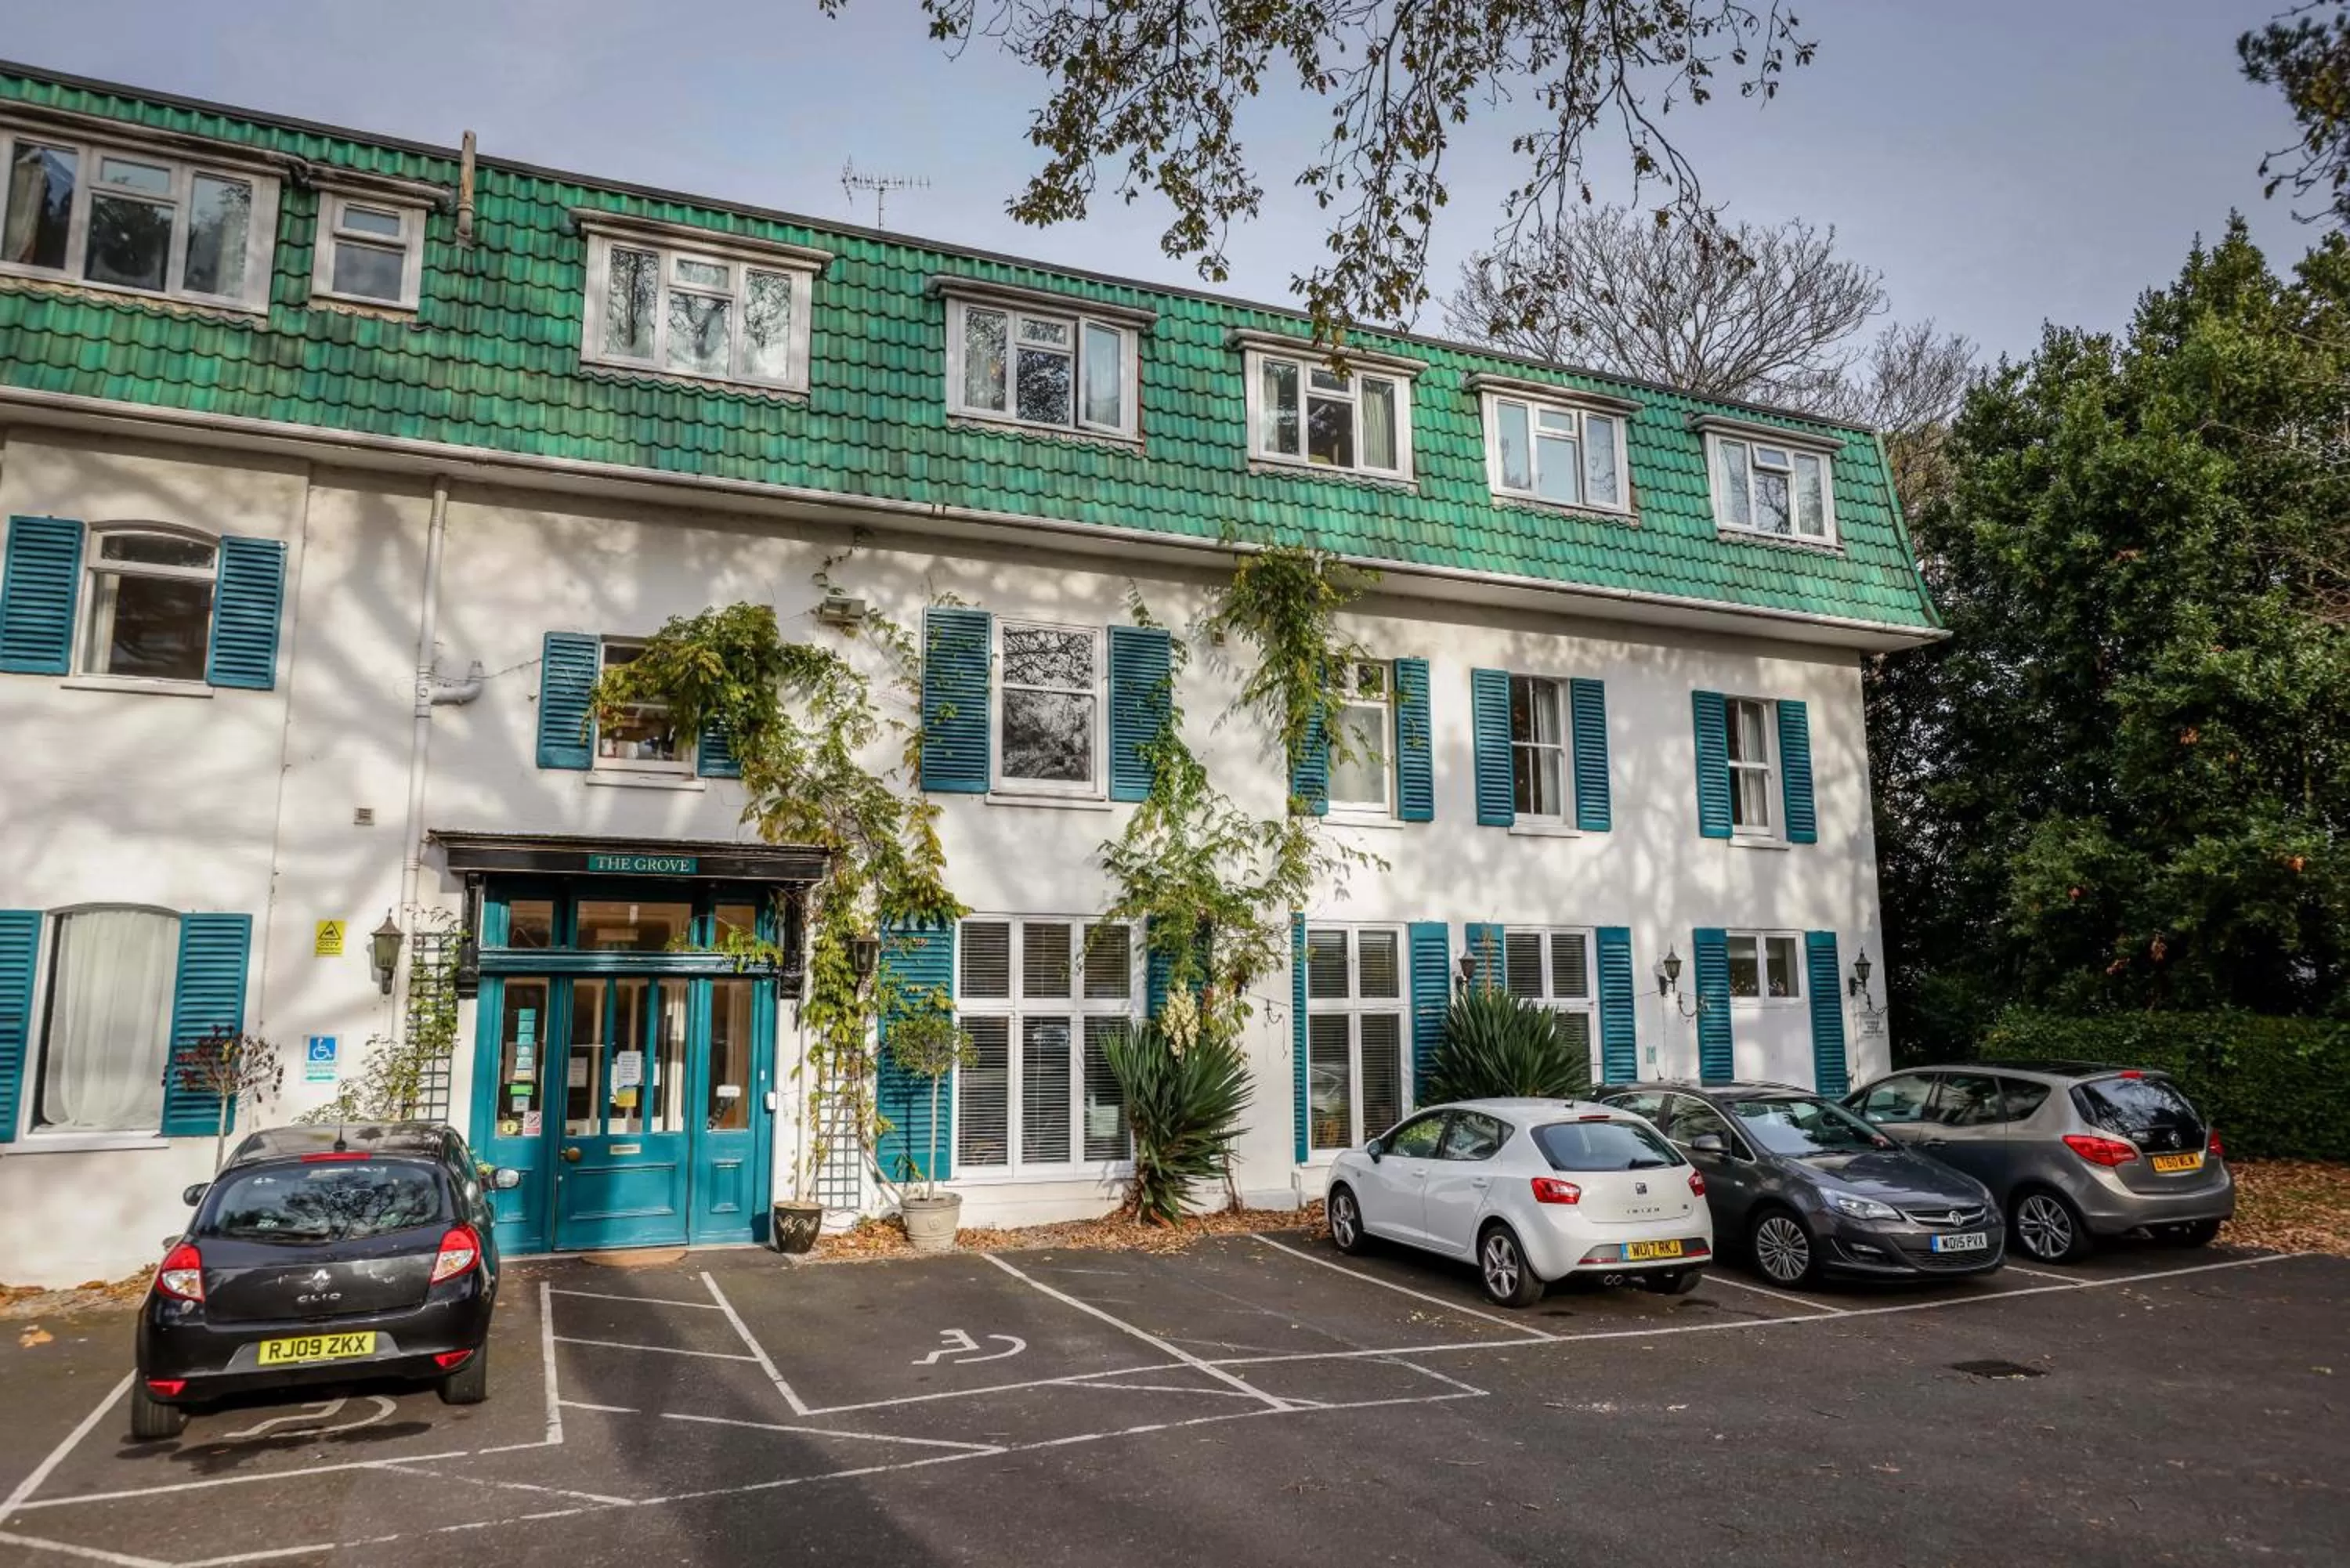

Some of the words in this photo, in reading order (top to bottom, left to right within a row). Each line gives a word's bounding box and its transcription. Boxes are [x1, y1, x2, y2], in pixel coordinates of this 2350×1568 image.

[596, 857, 630, 870] THE
[634, 858, 690, 872] GROVE
[297, 1292, 342, 1302] CLIO
[269, 1339, 322, 1360] RJ09
[327, 1335, 367, 1354] ZKX
